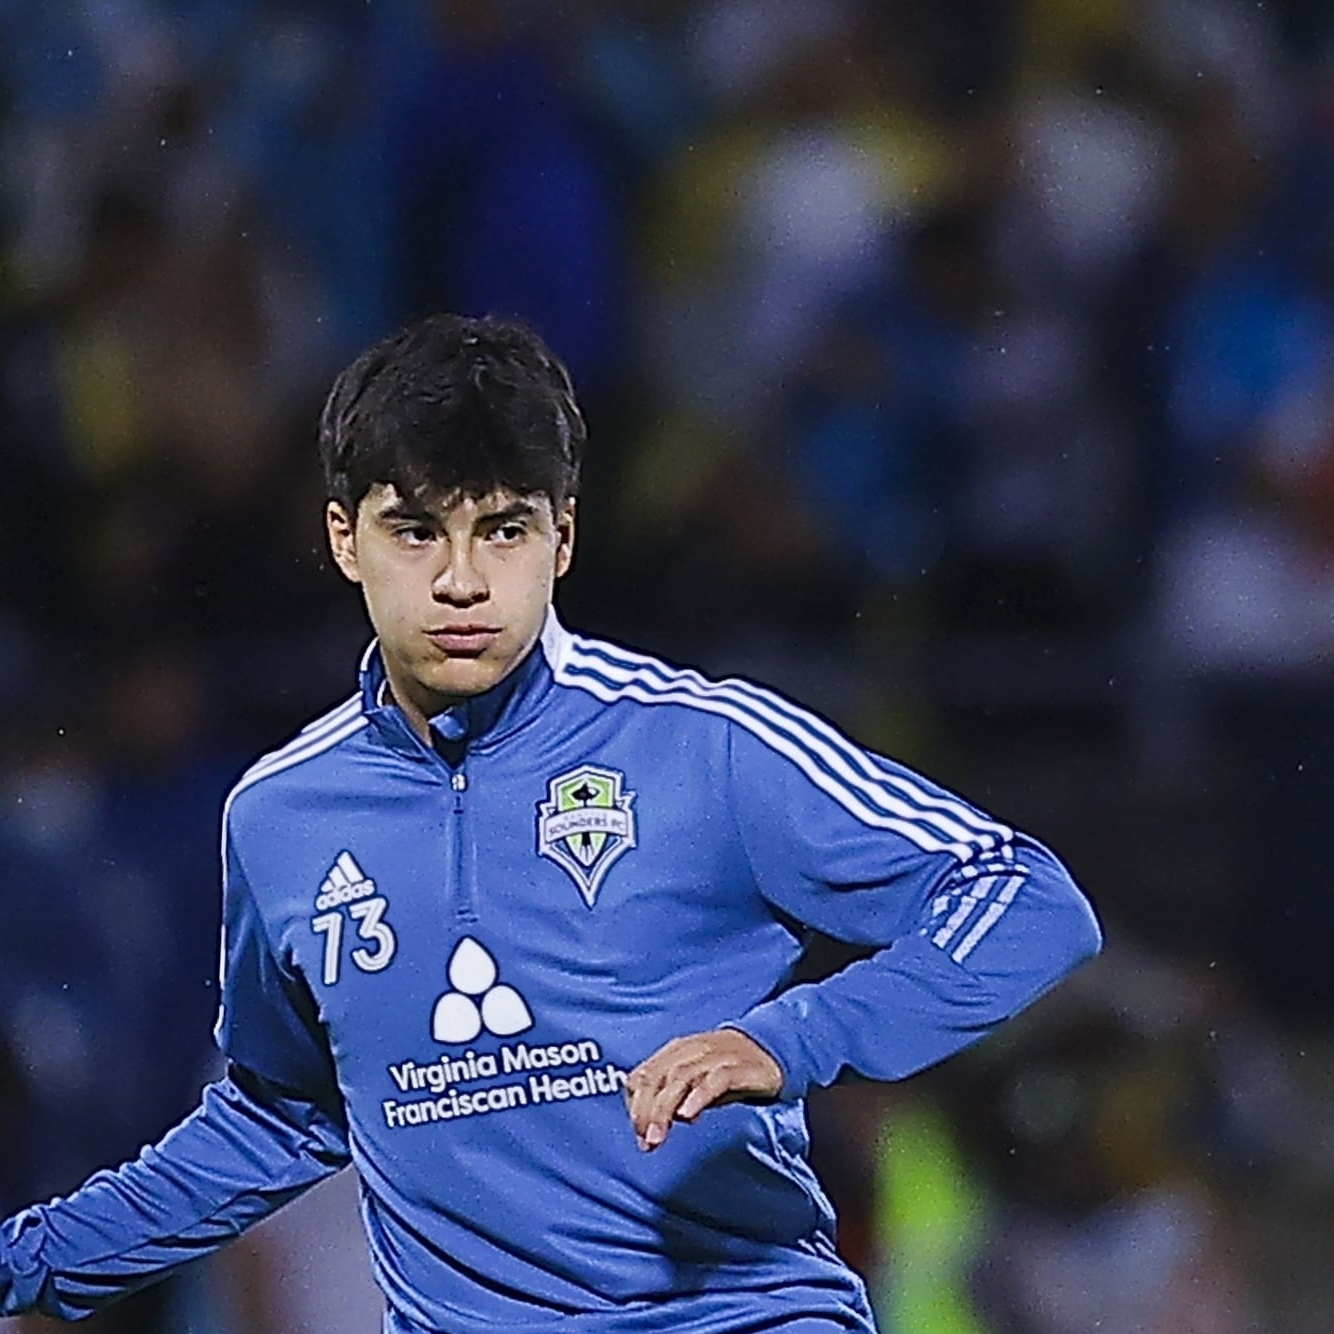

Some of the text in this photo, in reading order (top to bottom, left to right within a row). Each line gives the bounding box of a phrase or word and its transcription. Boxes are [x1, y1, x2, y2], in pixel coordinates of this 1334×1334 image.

[316, 879, 375, 911] adidas
[312, 897, 395, 985] 73
[390, 1041, 600, 1093] Virginia Mason
[383, 1065, 627, 1128] Franciscan Health
